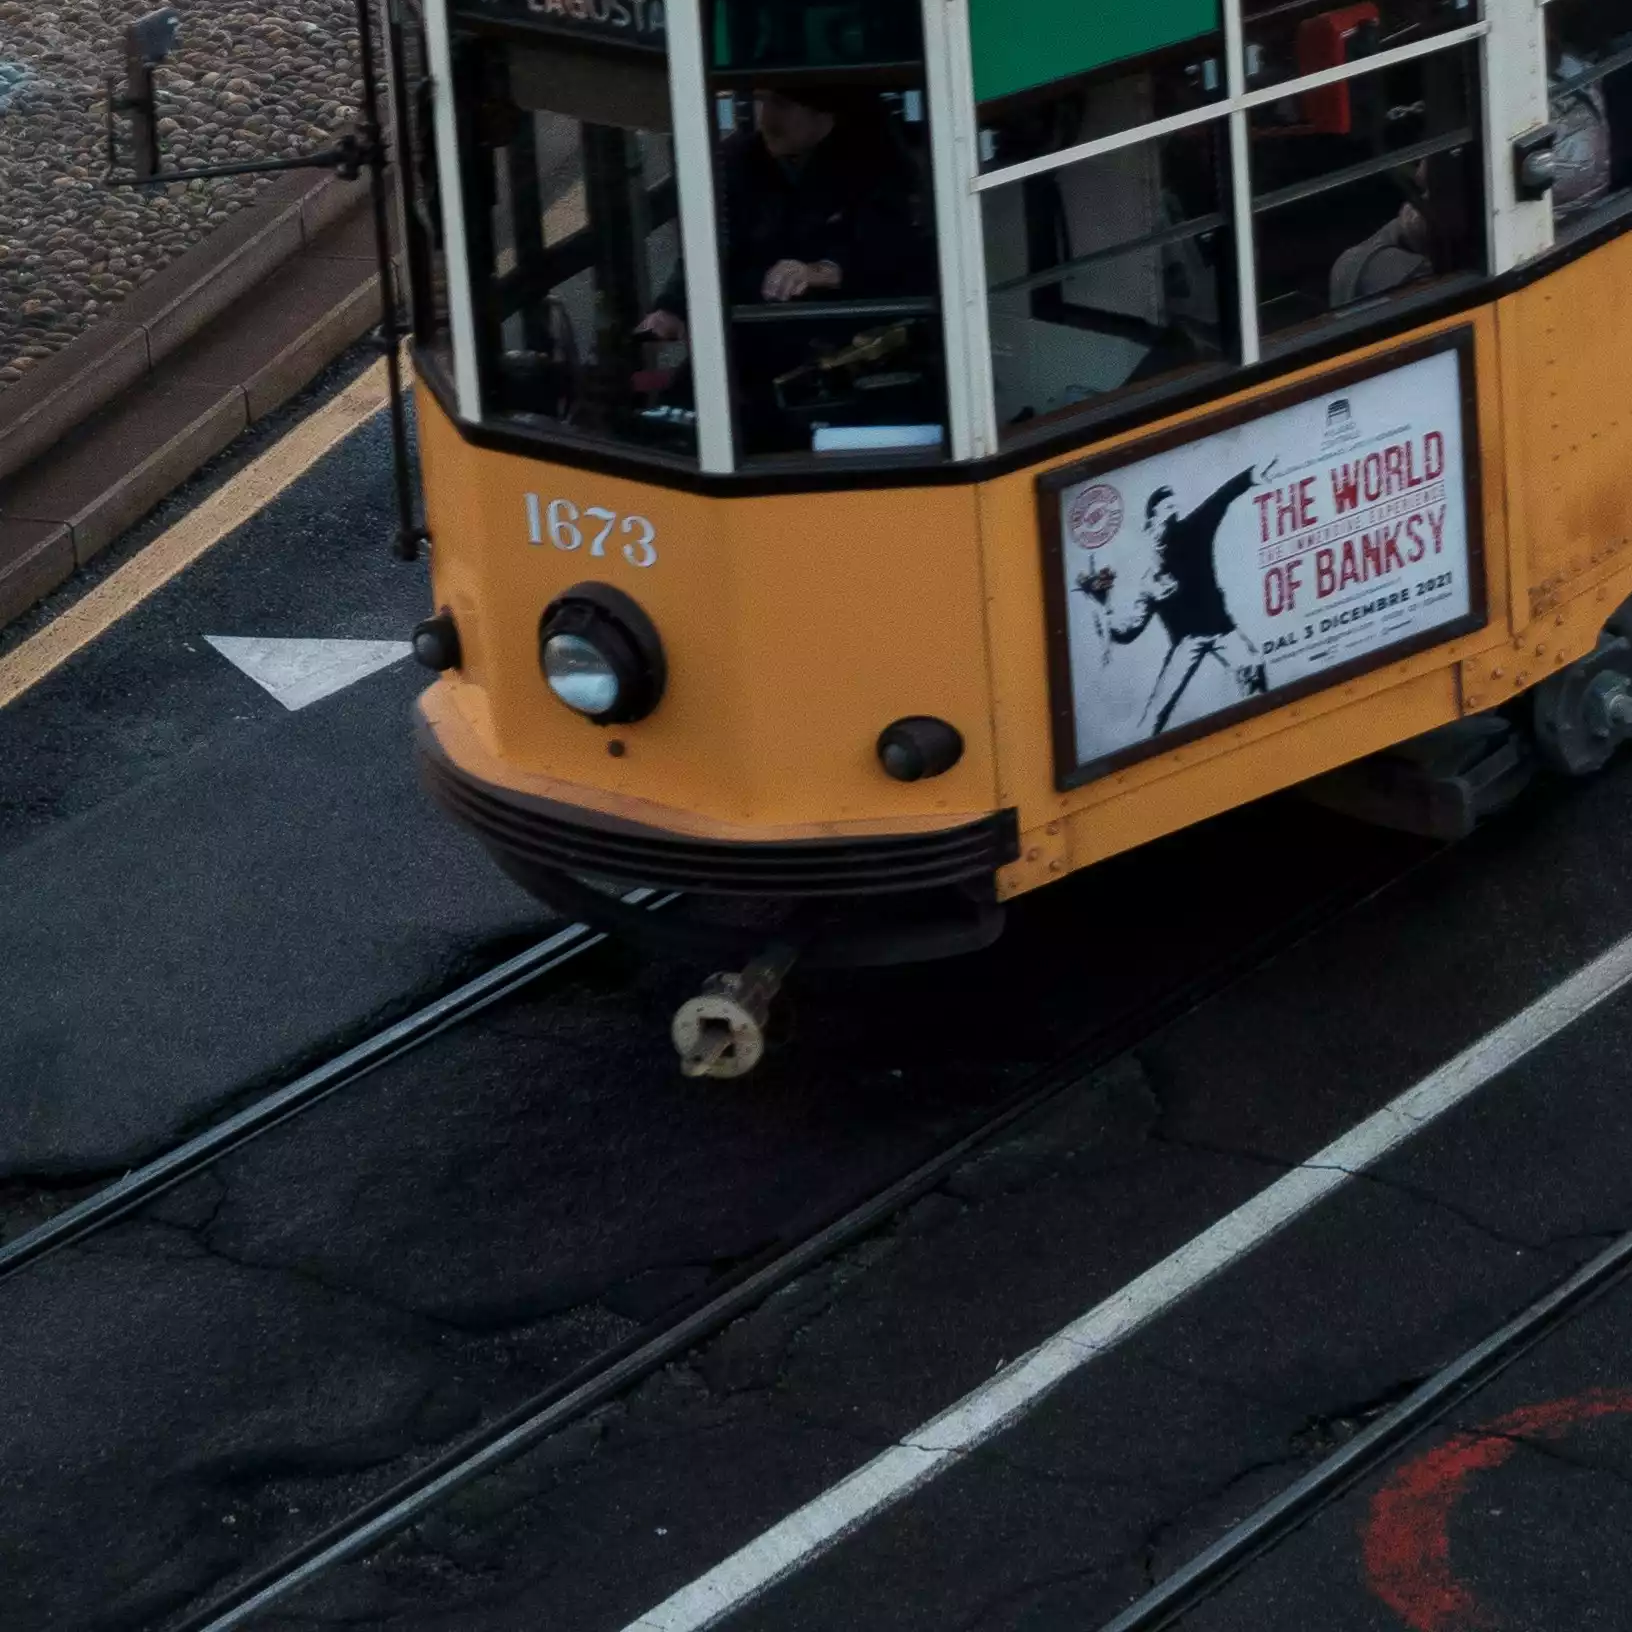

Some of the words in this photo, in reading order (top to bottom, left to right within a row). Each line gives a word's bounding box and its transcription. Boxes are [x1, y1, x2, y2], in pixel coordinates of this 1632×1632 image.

[522, 490, 659, 568] 1673
[1253, 475, 1319, 542] THE
[1330, 431, 1446, 514] WORLD
[1263, 559, 1303, 617] OF
[1316, 504, 1447, 599] BANKSY
[1262, 632, 1298, 655] DAL
[1304, 624, 1314, 639] 3
[1320, 587, 1411, 633] DICEMBRE
[1415, 571, 1453, 597] 2021
